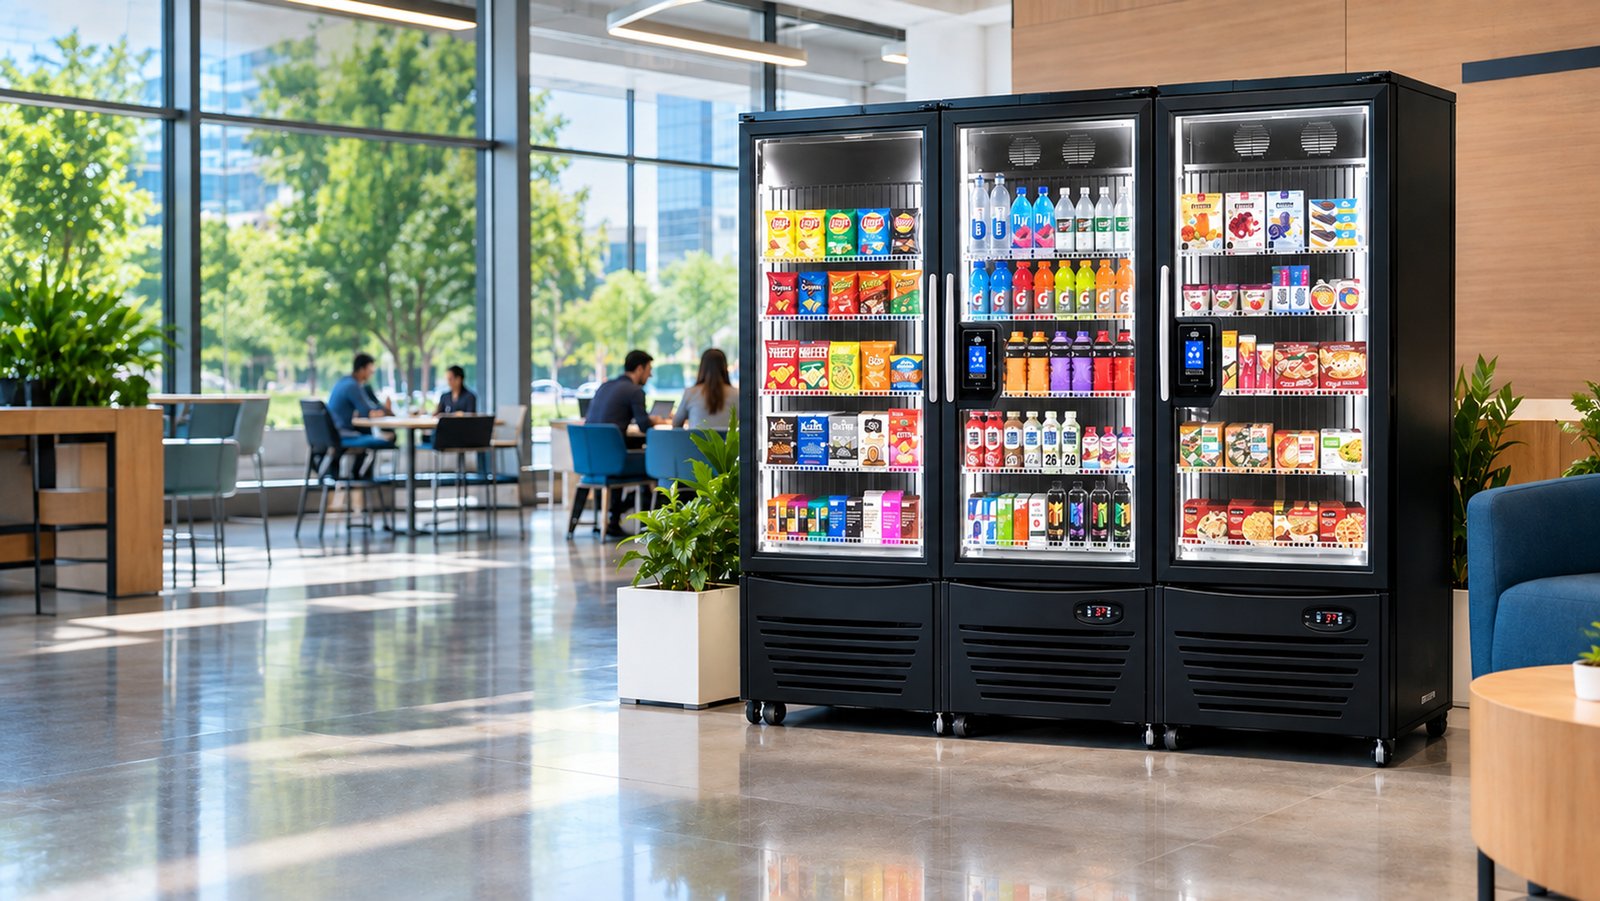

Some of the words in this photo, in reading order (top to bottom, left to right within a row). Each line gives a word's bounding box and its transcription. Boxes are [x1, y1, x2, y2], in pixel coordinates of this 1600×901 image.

[973, 292, 982, 306] G
[994, 292, 1004, 306] G
[1016, 292, 1026, 305] G
[1038, 292, 1048, 305] G
[1059, 291, 1069, 304] G
[1079, 291, 1089, 304] G
[1099, 291, 1110, 304] G
